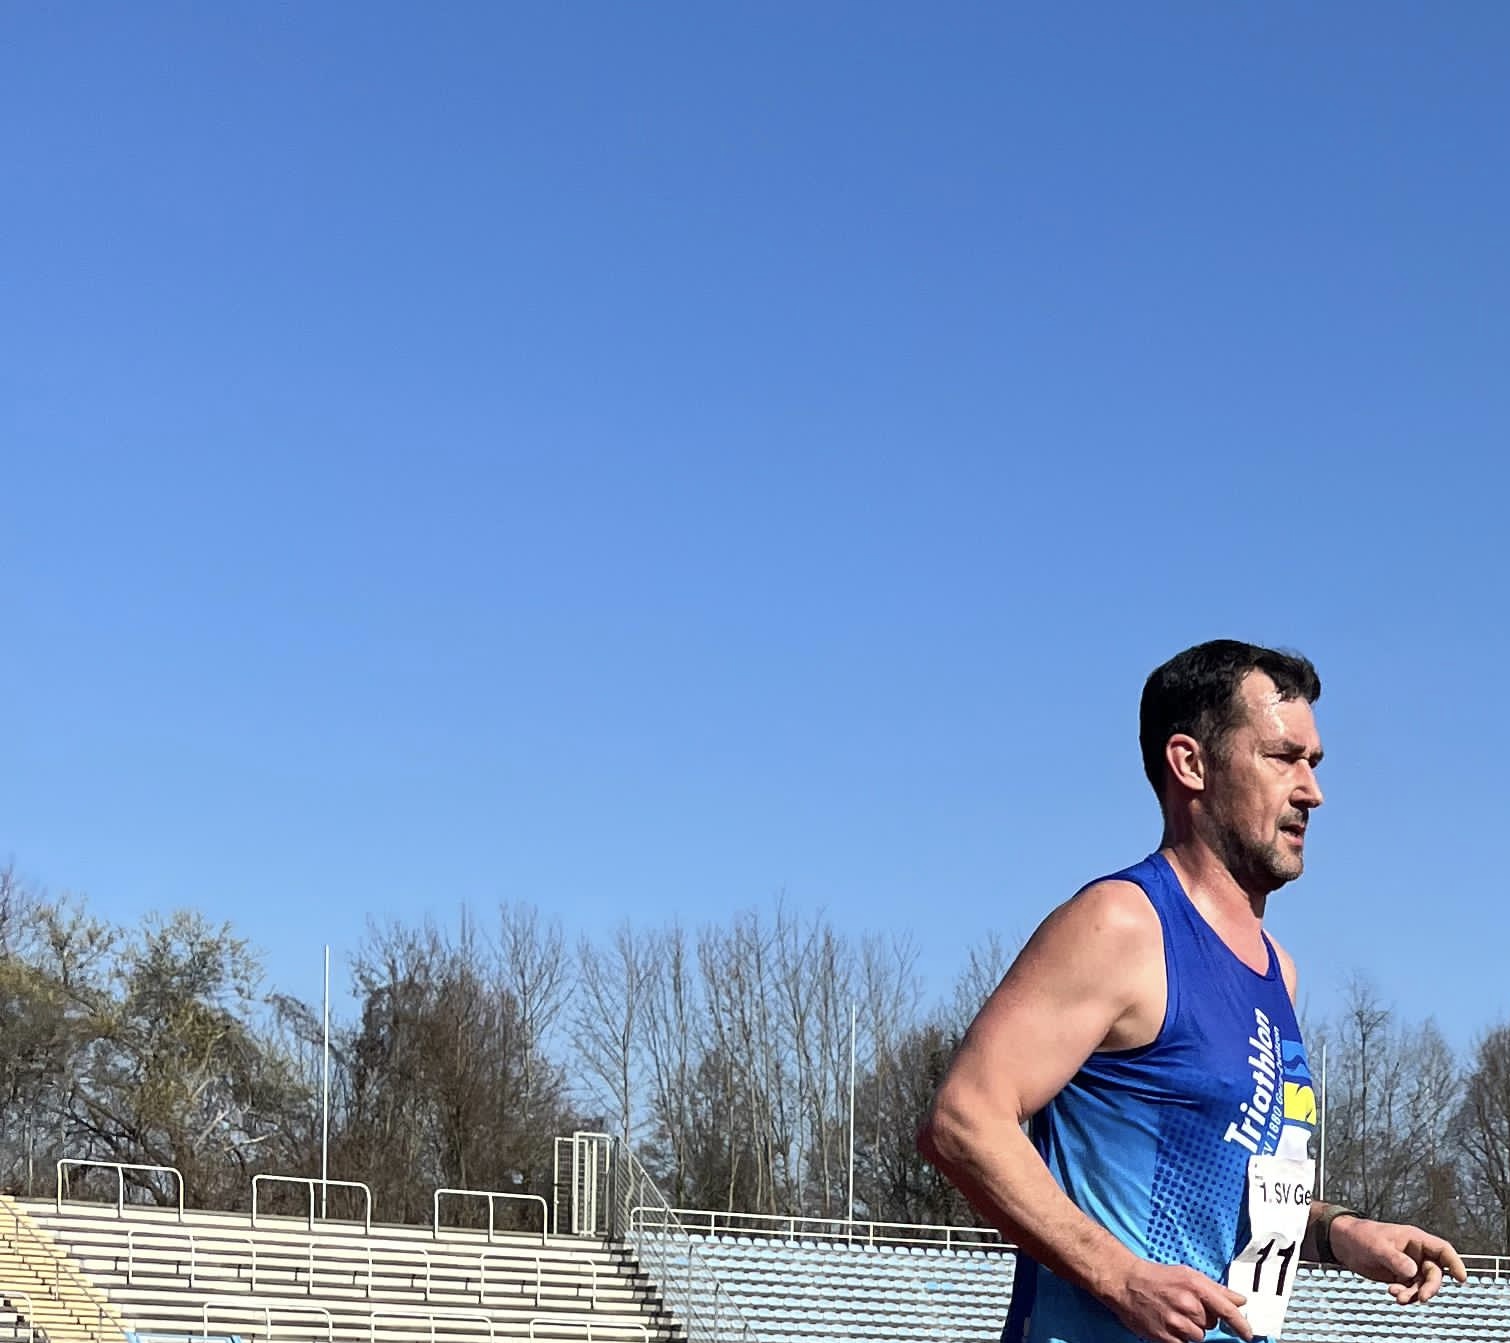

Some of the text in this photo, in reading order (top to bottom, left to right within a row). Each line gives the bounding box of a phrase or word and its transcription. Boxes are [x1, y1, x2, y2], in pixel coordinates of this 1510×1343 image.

[1224, 1008, 1276, 1154] Triathlon
[1266, 1107, 1283, 1141] 1880
[1274, 1182, 1291, 1205] SV
[1252, 1238, 1296, 1296] 11
